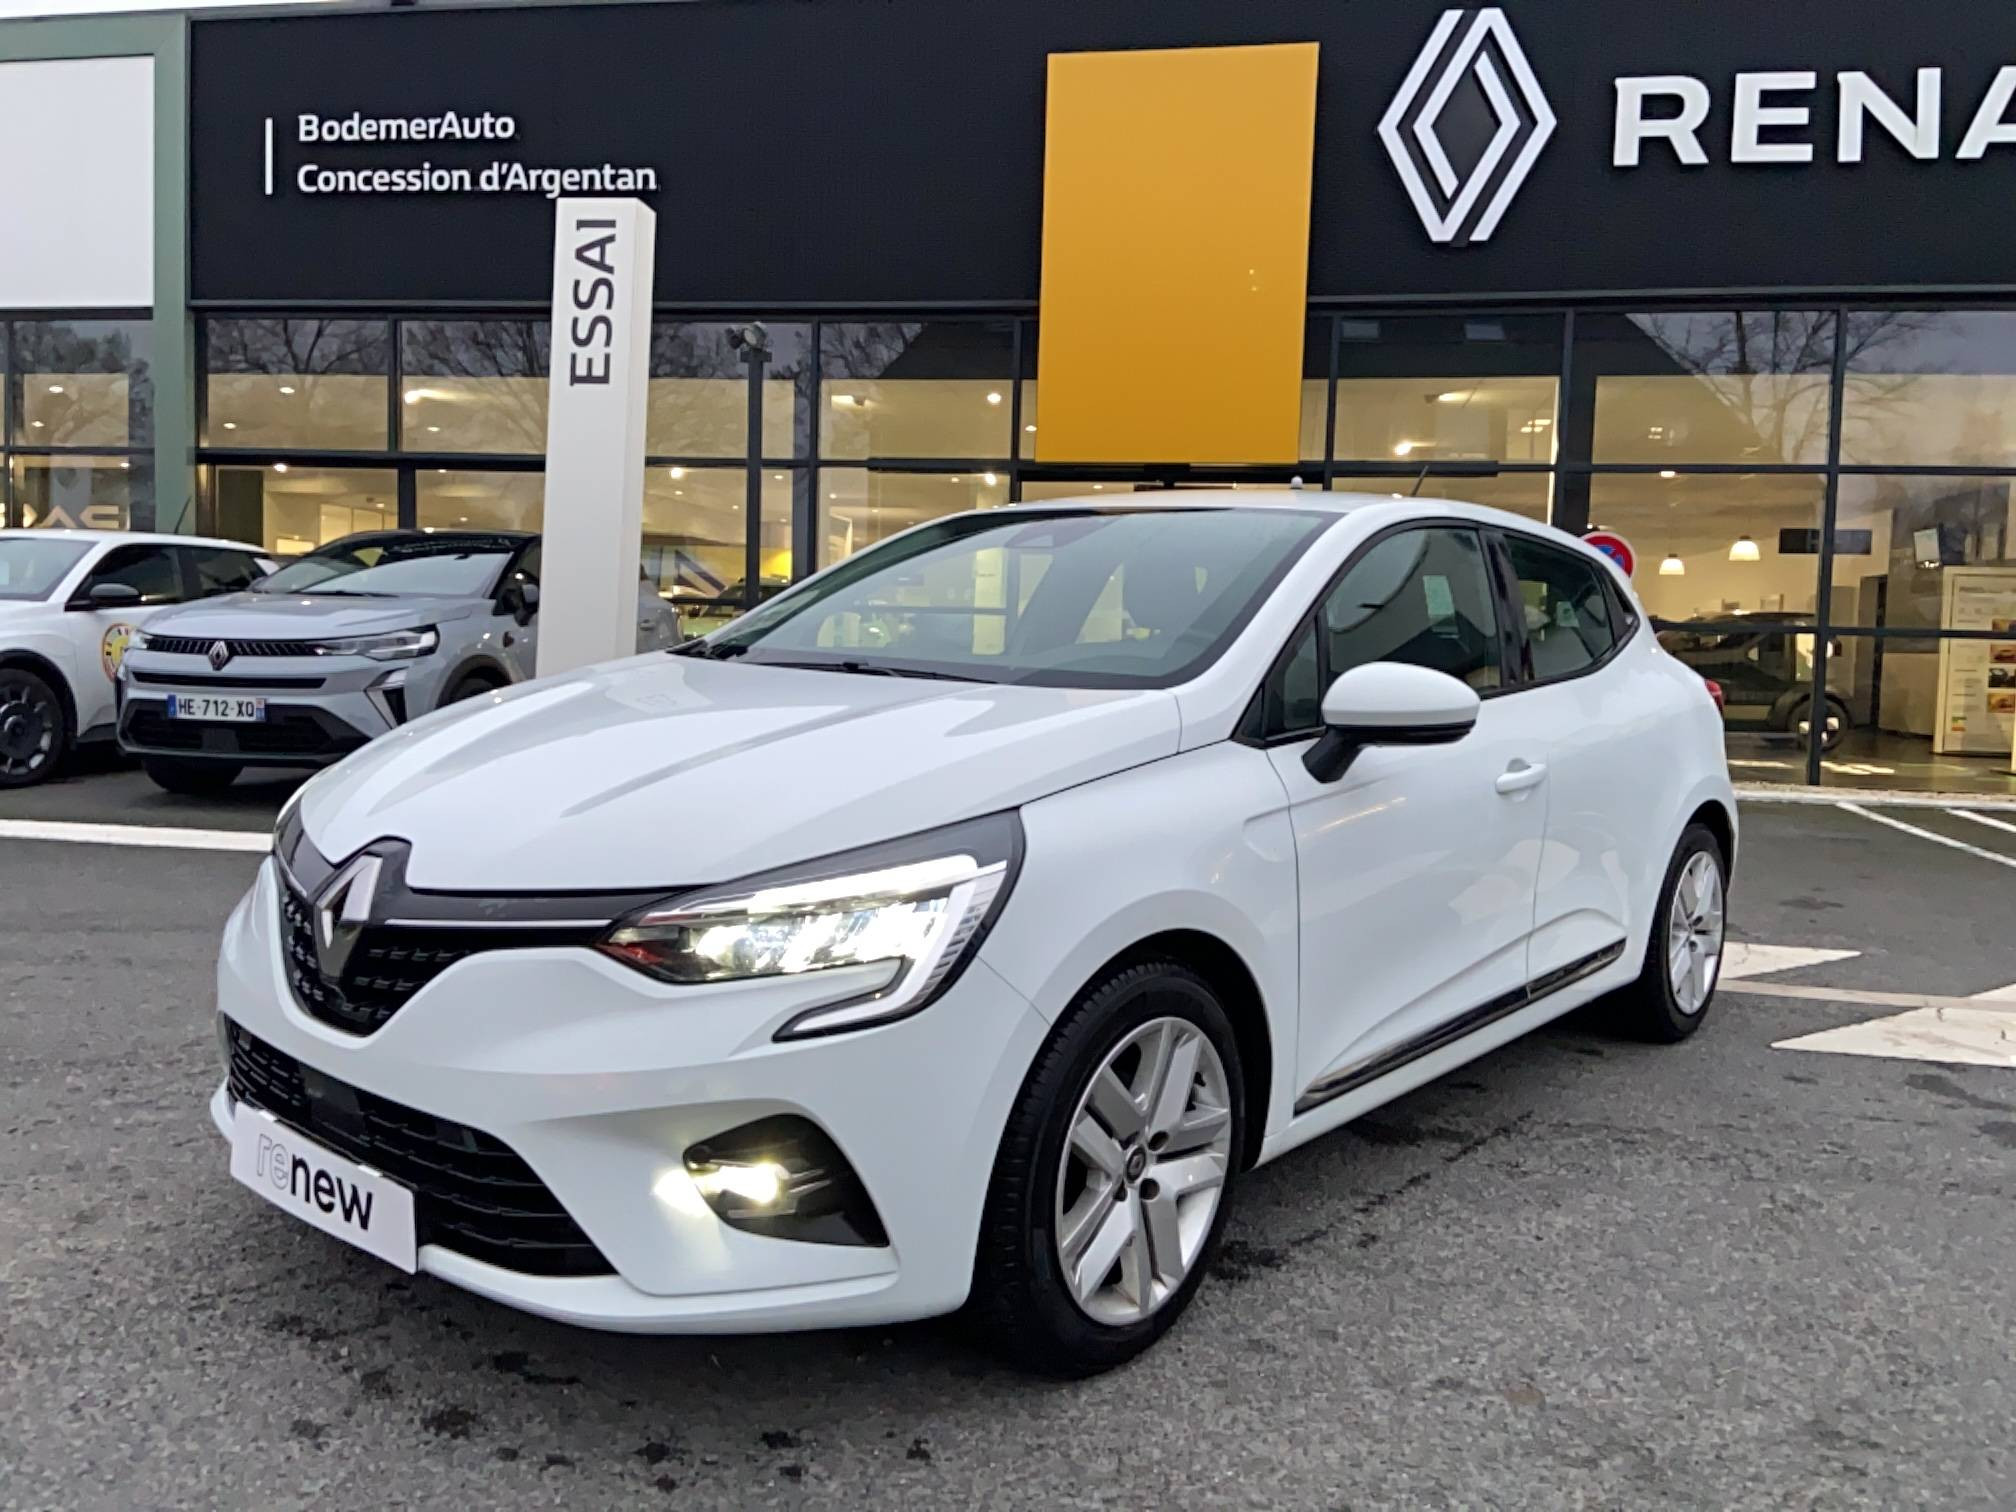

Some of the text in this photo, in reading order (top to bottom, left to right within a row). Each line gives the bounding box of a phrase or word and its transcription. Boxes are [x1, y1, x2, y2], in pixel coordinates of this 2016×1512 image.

[298, 111, 516, 142] BodemerAuto
[297, 162, 472, 193] Concession
[570, 218, 617, 387] ESSAI
[257, 1133, 373, 1231] renew
